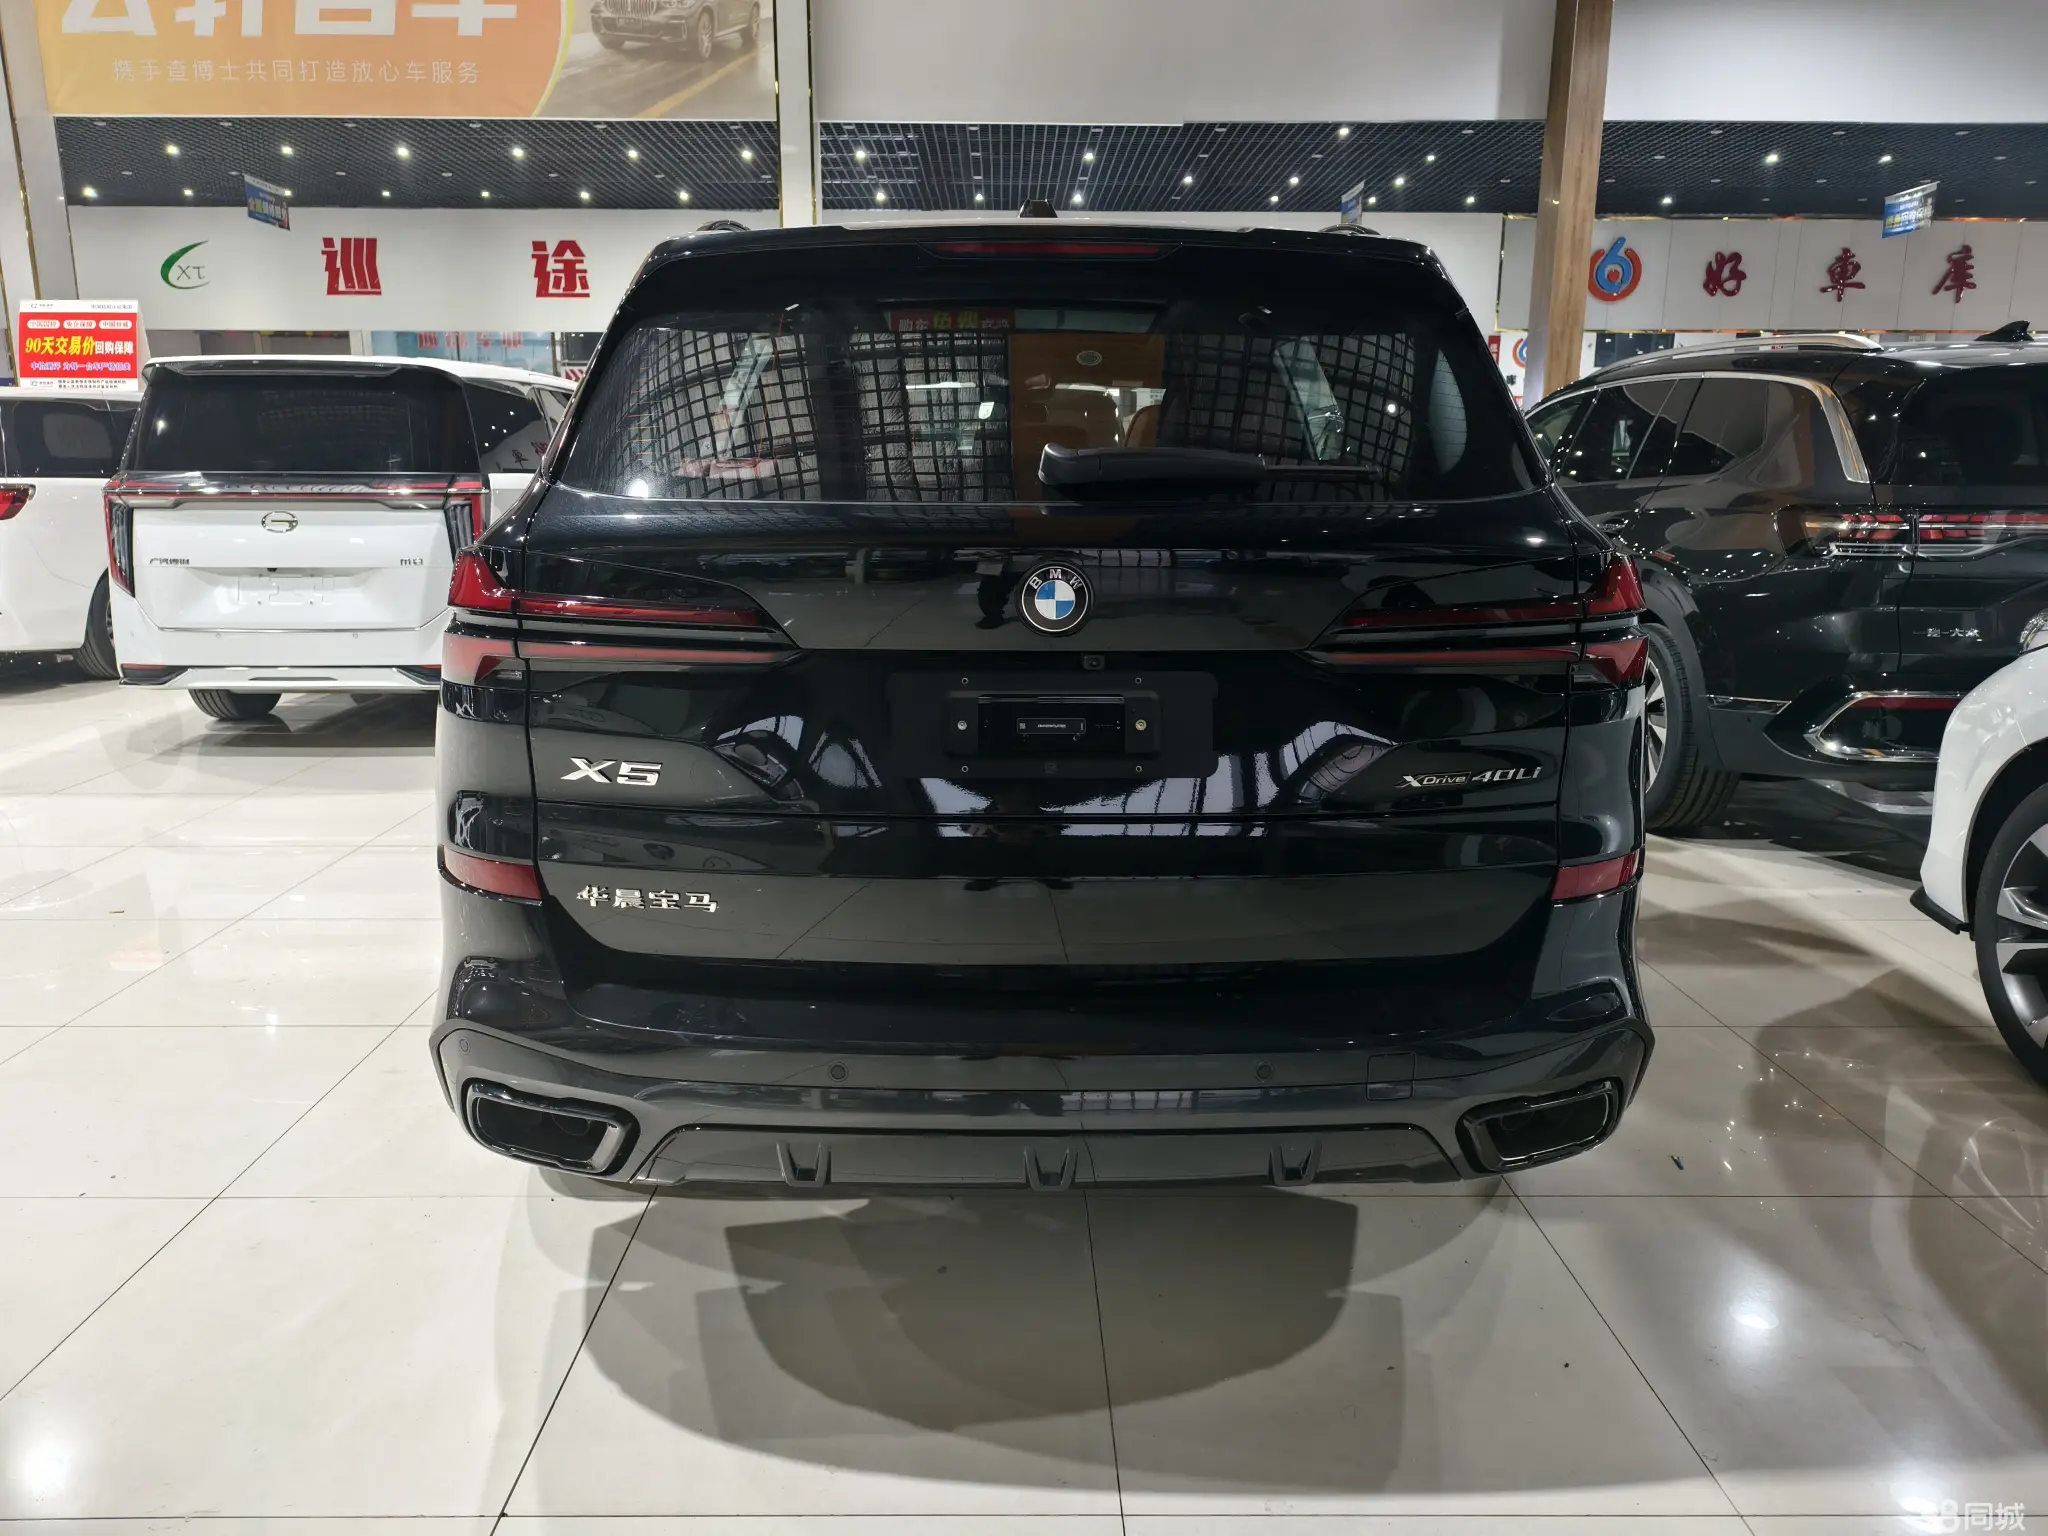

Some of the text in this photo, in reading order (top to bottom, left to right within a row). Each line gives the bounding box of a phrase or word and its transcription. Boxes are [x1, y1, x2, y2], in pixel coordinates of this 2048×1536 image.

[113, 59, 481, 85] 携手查博士共同打造放心车服务
[321, 237, 590, 298] 巡途
[1029, 568, 1083, 590] BMW
[560, 756, 664, 787] X5
[1471, 765, 1543, 783] 40Li
[576, 884, 720, 913] 华晨宝马
